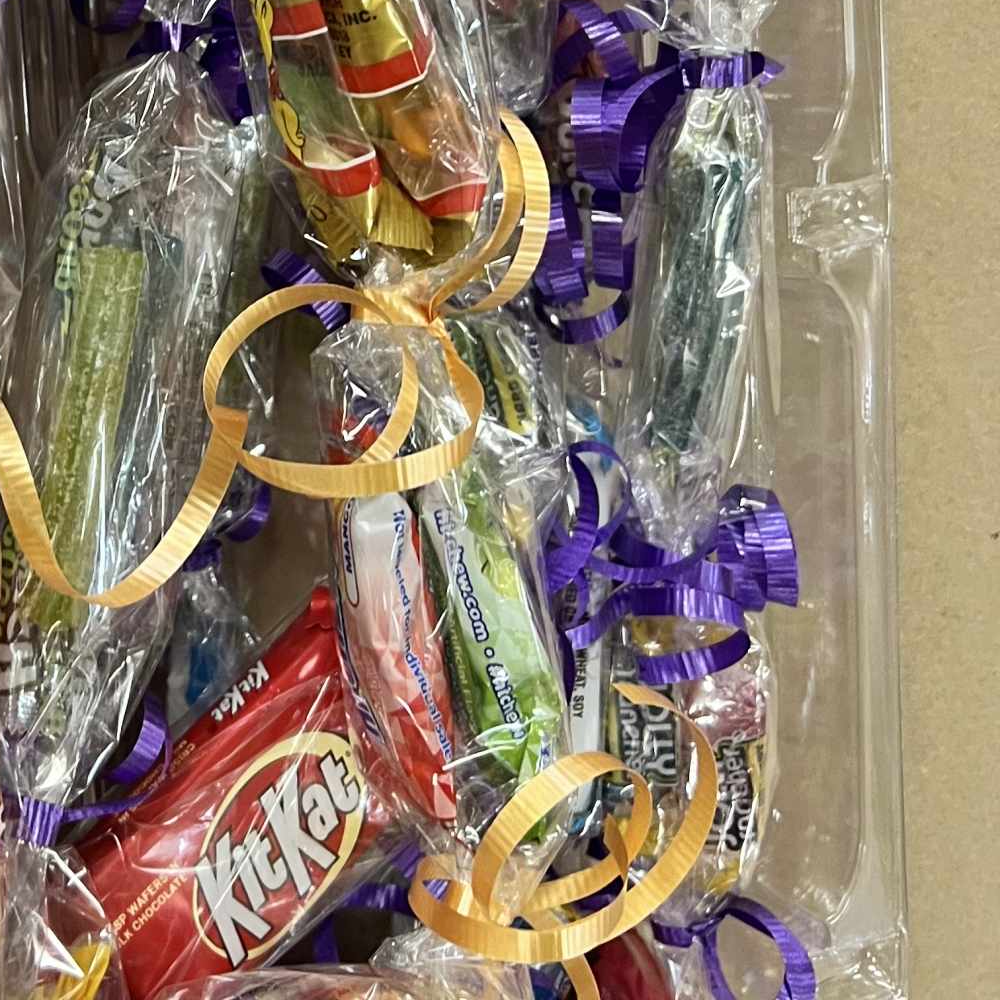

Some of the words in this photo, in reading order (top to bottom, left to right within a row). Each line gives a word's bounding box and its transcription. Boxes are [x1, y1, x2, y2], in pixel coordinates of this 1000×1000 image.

[433, 507, 489, 643] hi-chew.com
[210, 660, 270, 723] KitKat
[571, 648, 590, 692] WHEAT,
[571, 694, 585, 719] SOY
[197, 752, 364, 968] KitKat
[126, 874, 169, 916] WAFERS
[129, 872, 191, 934] CHOCOLATE
